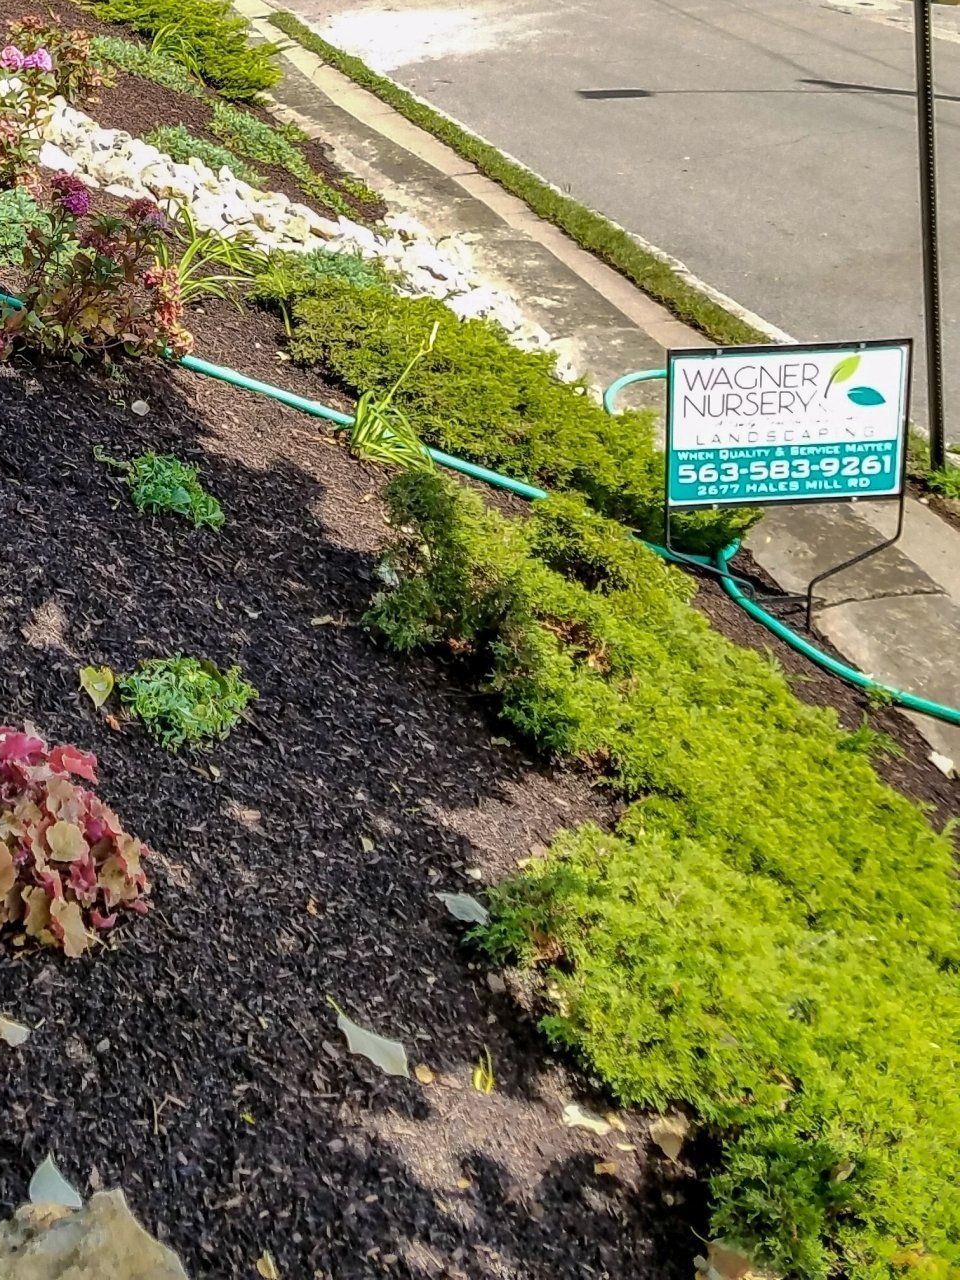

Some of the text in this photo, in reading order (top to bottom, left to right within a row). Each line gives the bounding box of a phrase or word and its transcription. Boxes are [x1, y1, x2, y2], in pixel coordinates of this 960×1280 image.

[682, 363, 820, 392] WAGNER
[683, 389, 818, 418] NURSERY
[696, 426, 875, 446] LANDSCAPNG
[775, 446, 785, 457] &
[678, 455, 892, 484] 563-583-9261
[697, 477, 871, 496] 2677 HALES MILL RD
